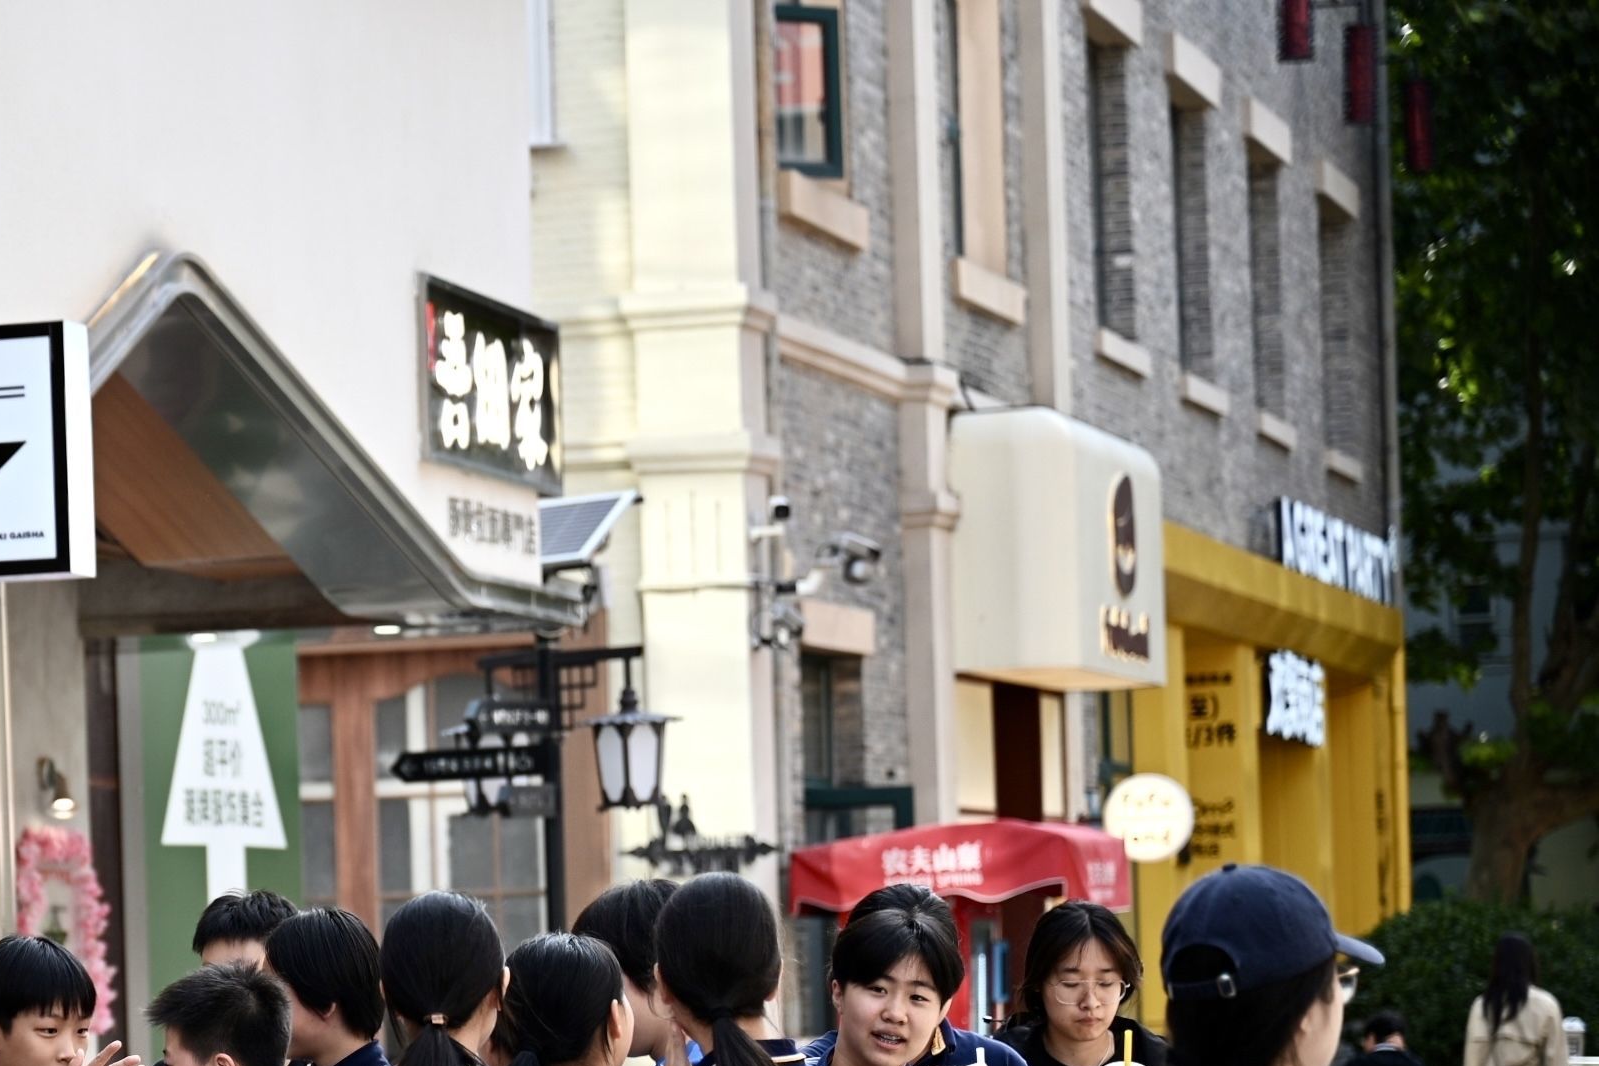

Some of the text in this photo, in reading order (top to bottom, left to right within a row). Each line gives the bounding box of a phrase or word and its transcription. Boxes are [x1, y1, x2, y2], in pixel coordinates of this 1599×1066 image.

[9, 530, 45, 540] GAISHA
[882, 840, 984, 873] 农夫山泉
